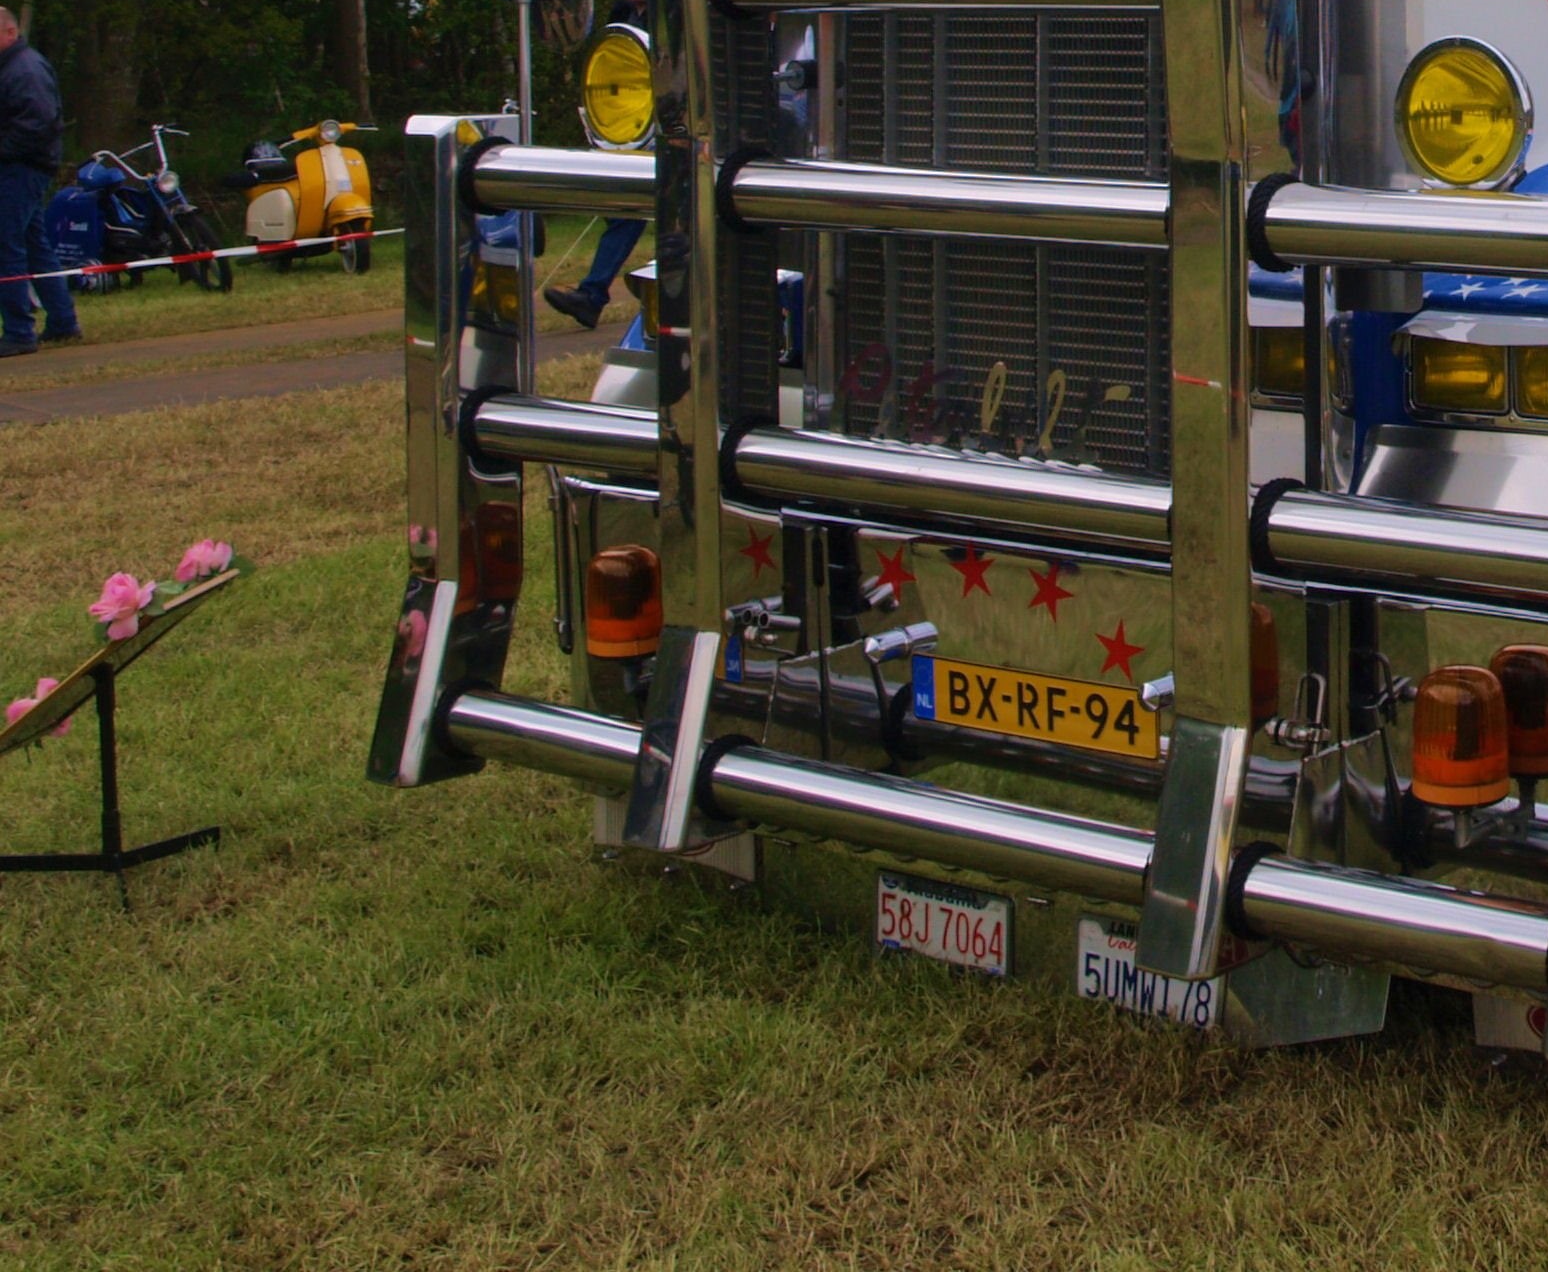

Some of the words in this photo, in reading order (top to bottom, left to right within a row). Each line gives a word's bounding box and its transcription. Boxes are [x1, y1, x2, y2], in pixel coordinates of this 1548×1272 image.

[916, 692, 933, 709] NL
[948, 670, 1139, 745] BX-RF-94
[938, 907, 1003, 966] 7064
